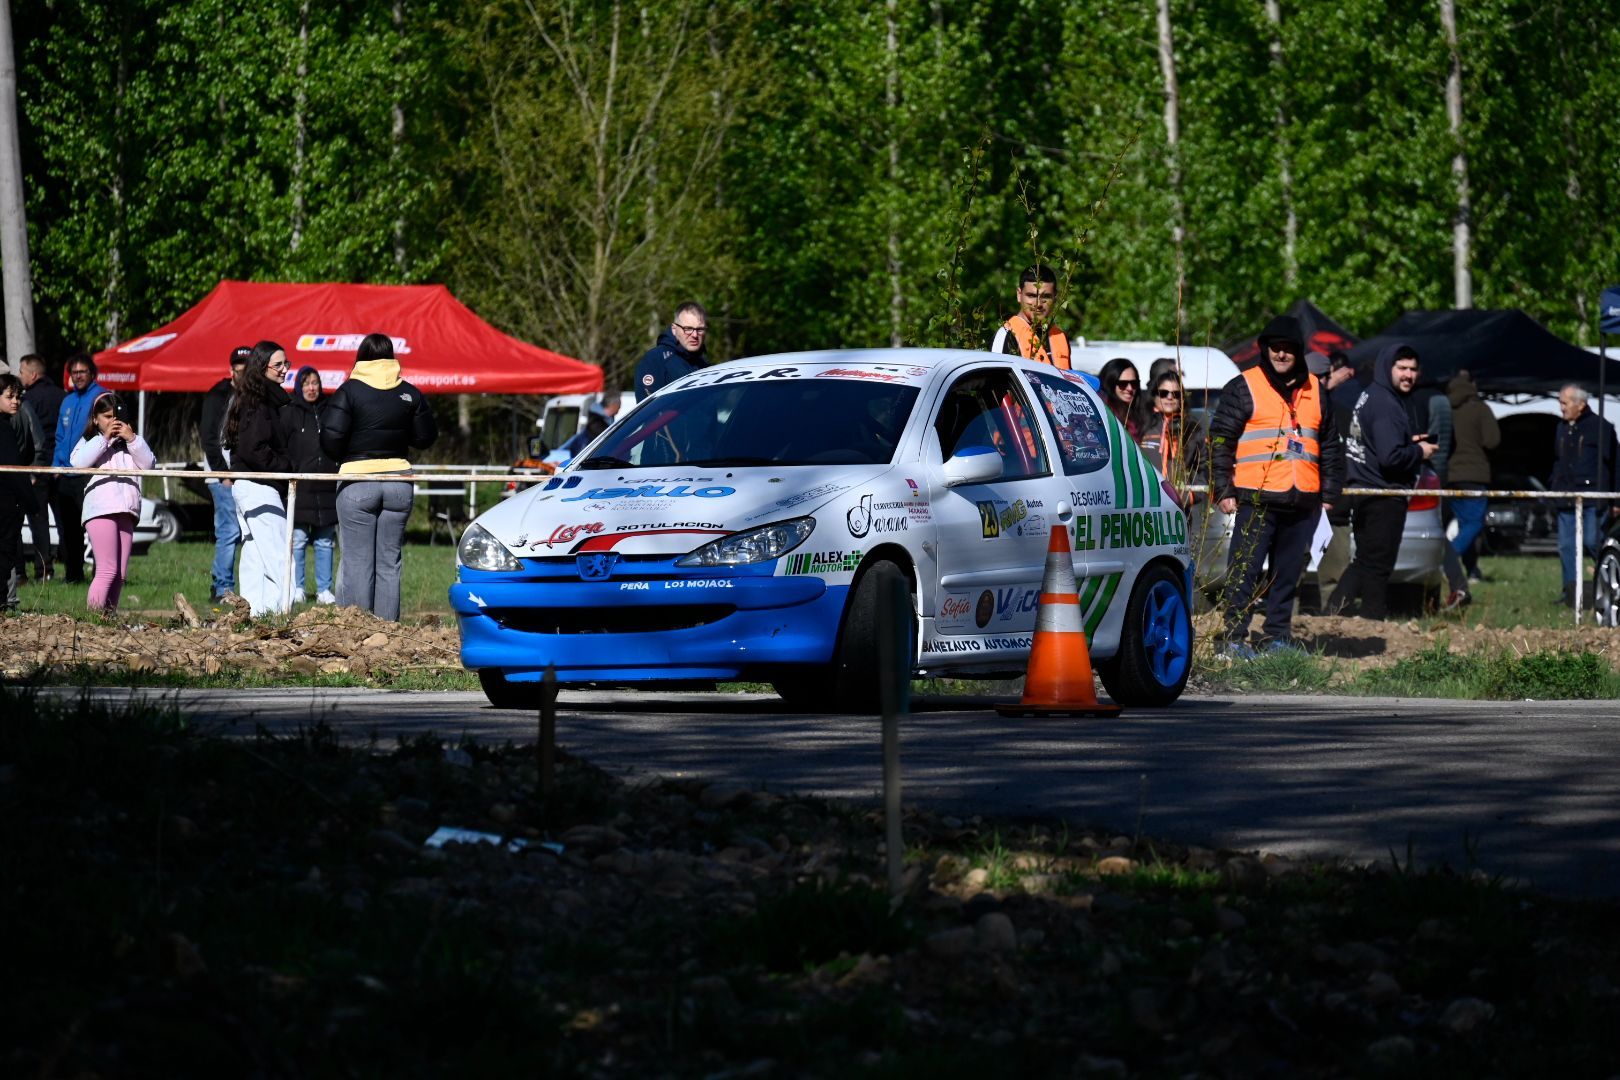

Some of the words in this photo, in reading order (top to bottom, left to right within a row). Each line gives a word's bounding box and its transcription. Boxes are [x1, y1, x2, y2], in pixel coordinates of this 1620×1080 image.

[1071, 490, 1112, 507] DESGUACE
[979, 502, 998, 536] 23
[616, 521, 724, 532] ROTULACION
[1075, 515, 1096, 551] EL
[1100, 510, 1186, 549] PENOSILLO
[812, 551, 843, 565] ALEX
[811, 563, 843, 574] MOTOR
[620, 581, 650, 591] PEÑA
[664, 580, 685, 589] LOS
